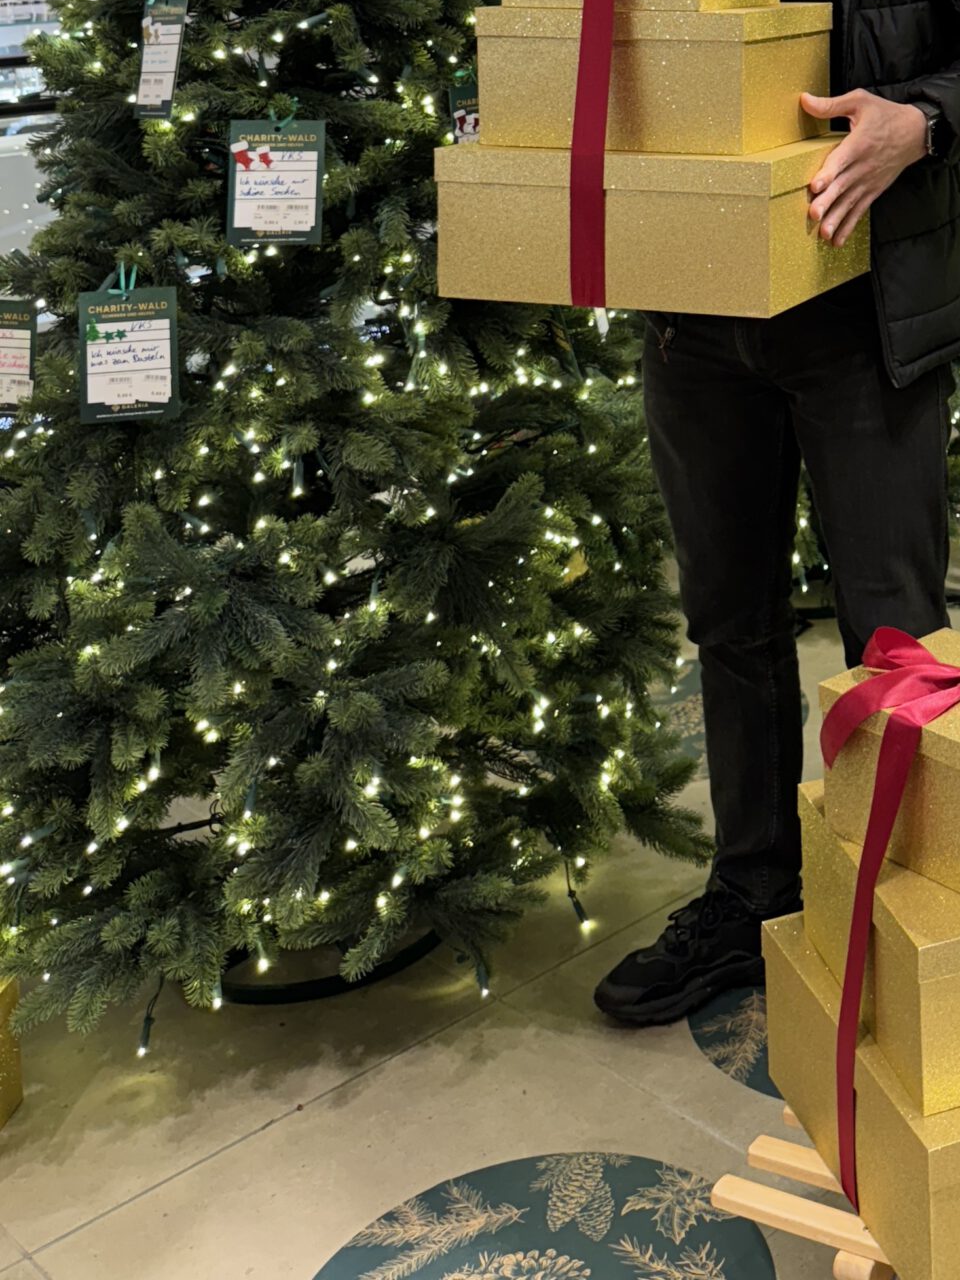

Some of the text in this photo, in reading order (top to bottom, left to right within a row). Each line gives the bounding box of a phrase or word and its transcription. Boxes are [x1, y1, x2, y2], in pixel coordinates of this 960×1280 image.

[239, 134, 317, 142] CHARITY-WALD
[87, 301, 169, 315] CHARITY-WALD
[0, 313, 31, 321] -WALD
